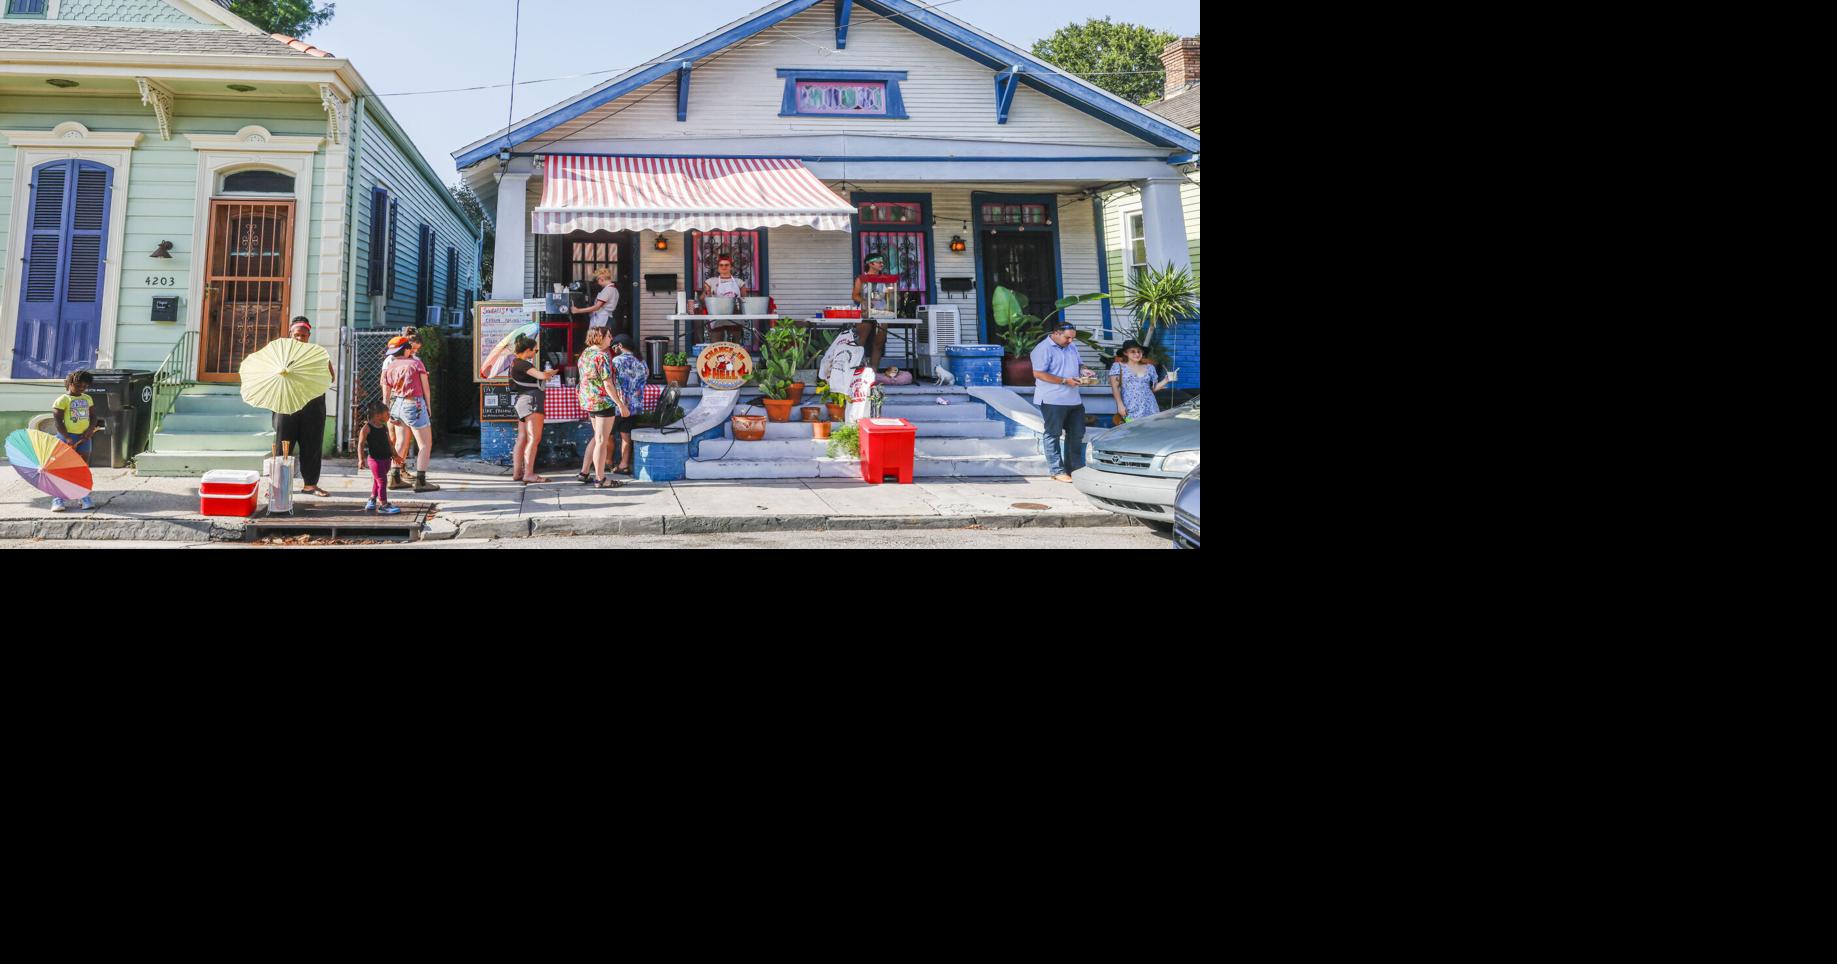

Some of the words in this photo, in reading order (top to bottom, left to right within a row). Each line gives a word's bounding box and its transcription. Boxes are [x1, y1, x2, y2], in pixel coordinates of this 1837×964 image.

[145, 276, 175, 286] 4203
[704, 346, 734, 360] CHANCE
[712, 368, 737, 379] HELL
